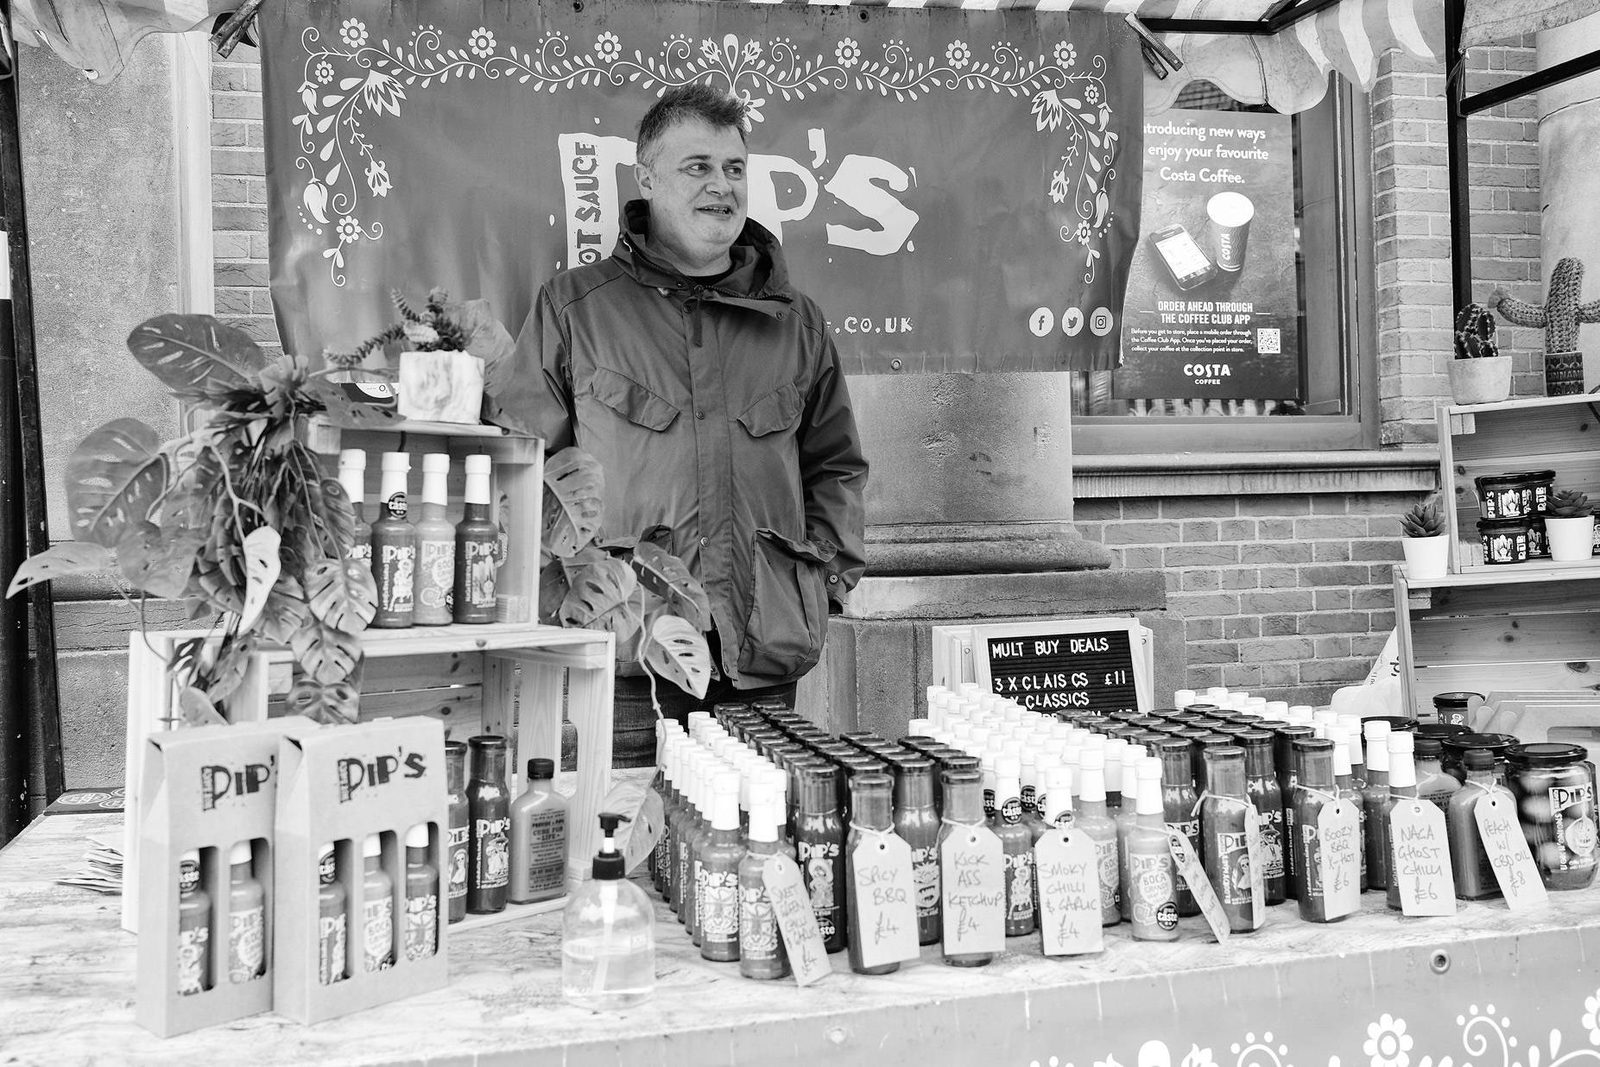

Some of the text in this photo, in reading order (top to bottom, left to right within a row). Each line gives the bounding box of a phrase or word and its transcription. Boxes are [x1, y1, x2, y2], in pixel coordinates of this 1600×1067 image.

[1209, 127, 1234, 137] new
[1237, 129, 1266, 143] ways
[1148, 142, 1269, 161] enjoy your favourite
[1160, 167, 1245, 183] Costa Coffee.
[572, 142, 602, 267] OT SAUCE
[1158, 301, 1253, 313] ORDER AHEAD THROUGH
[828, 316, 913, 334] .CO.UK
[1161, 313, 1251, 325] THE COFFEE CLUB APP
[1183, 364, 1231, 378] COSTA
[992, 637, 1110, 659] MULT BUY DEALS
[995, 678, 1004, 692] 3
[1008, 676, 1018, 691] X
[1104, 670, 1126, 686] £11
[1025, 692, 1090, 710] CLASSICS
[337, 746, 427, 803] PIP'S
[798, 842, 839, 862] PIP'S
[1398, 844, 1440, 861] GHOST
[1515, 850, 1530, 861] OIL
[957, 869, 981, 888] ASS
[1037, 862, 1087, 879] SMOKY
[873, 887, 907, 905] BBQ
[1046, 880, 1085, 895] CHILLI
[1414, 876, 1438, 904] £6
[948, 891, 1003, 909] KETCHUP
[875, 911, 899, 944] £4
[957, 906, 980, 942] £4
[1058, 913, 1081, 948] £4
